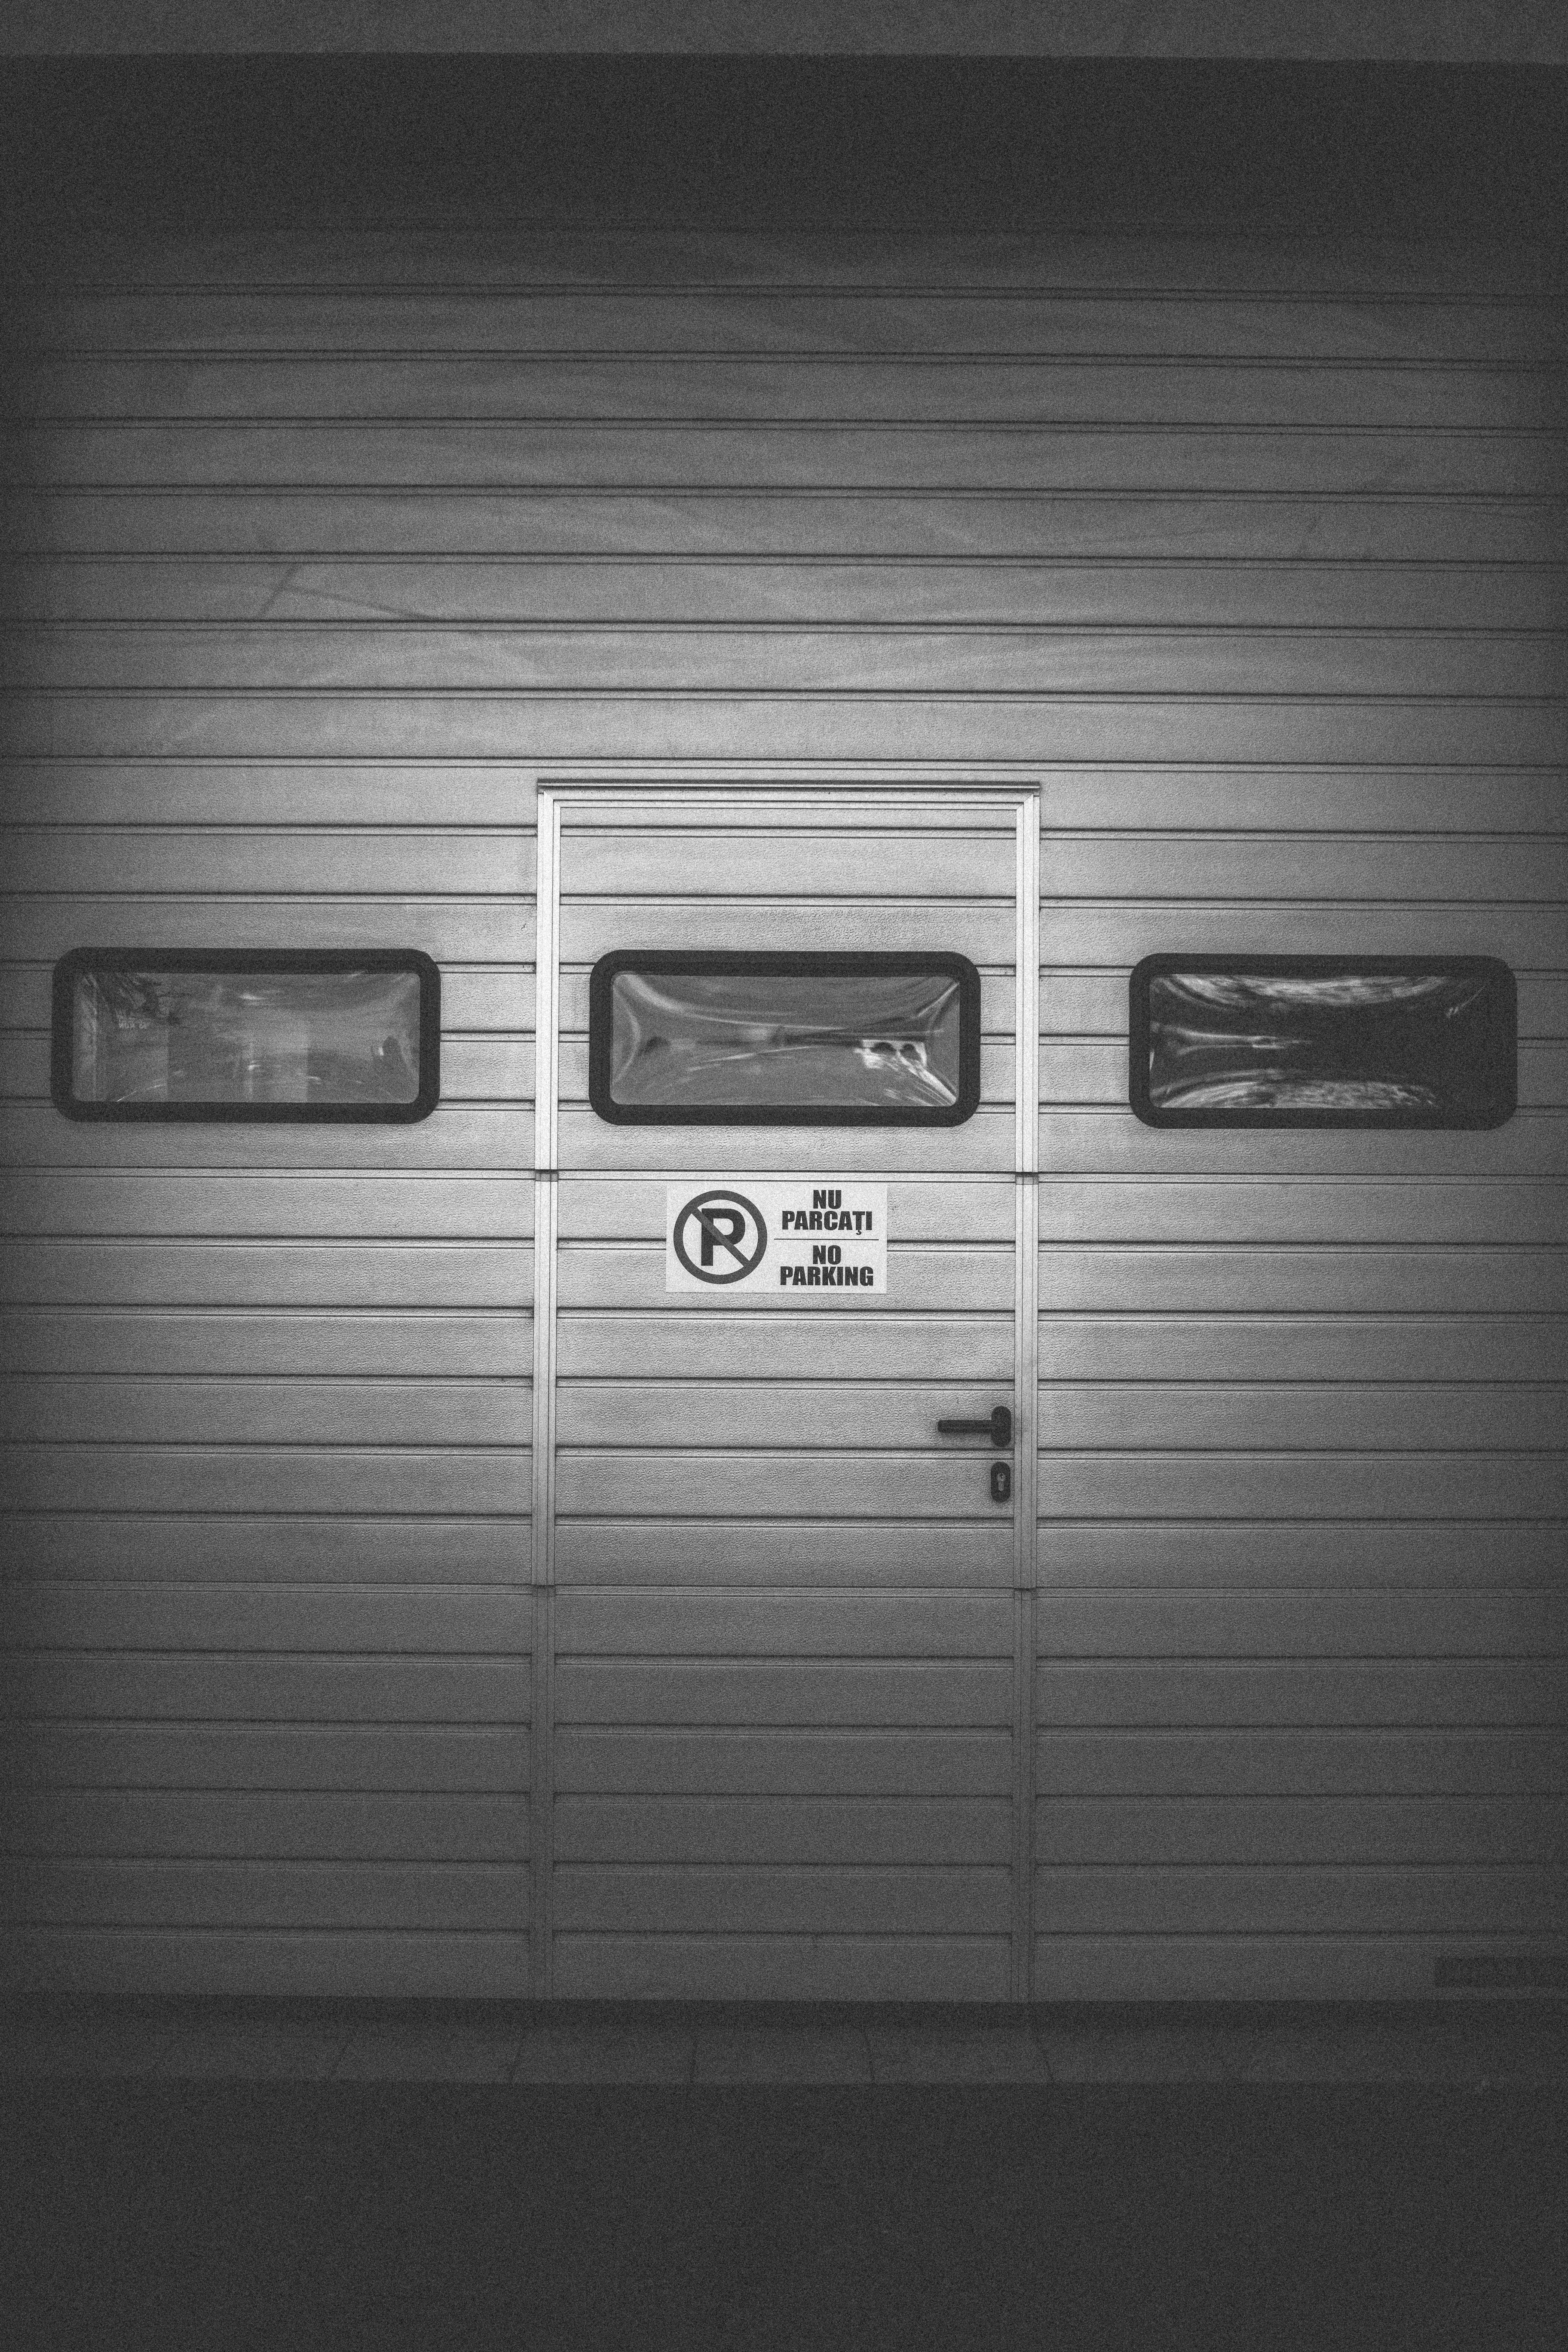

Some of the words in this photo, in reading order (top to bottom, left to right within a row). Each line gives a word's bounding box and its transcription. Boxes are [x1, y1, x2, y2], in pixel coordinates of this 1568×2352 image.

[813, 1190, 842, 1209] NU
[701, 1208, 746, 1266] P
[813, 1245, 841, 1265] NO
[780, 1266, 873, 1286] PARKING
